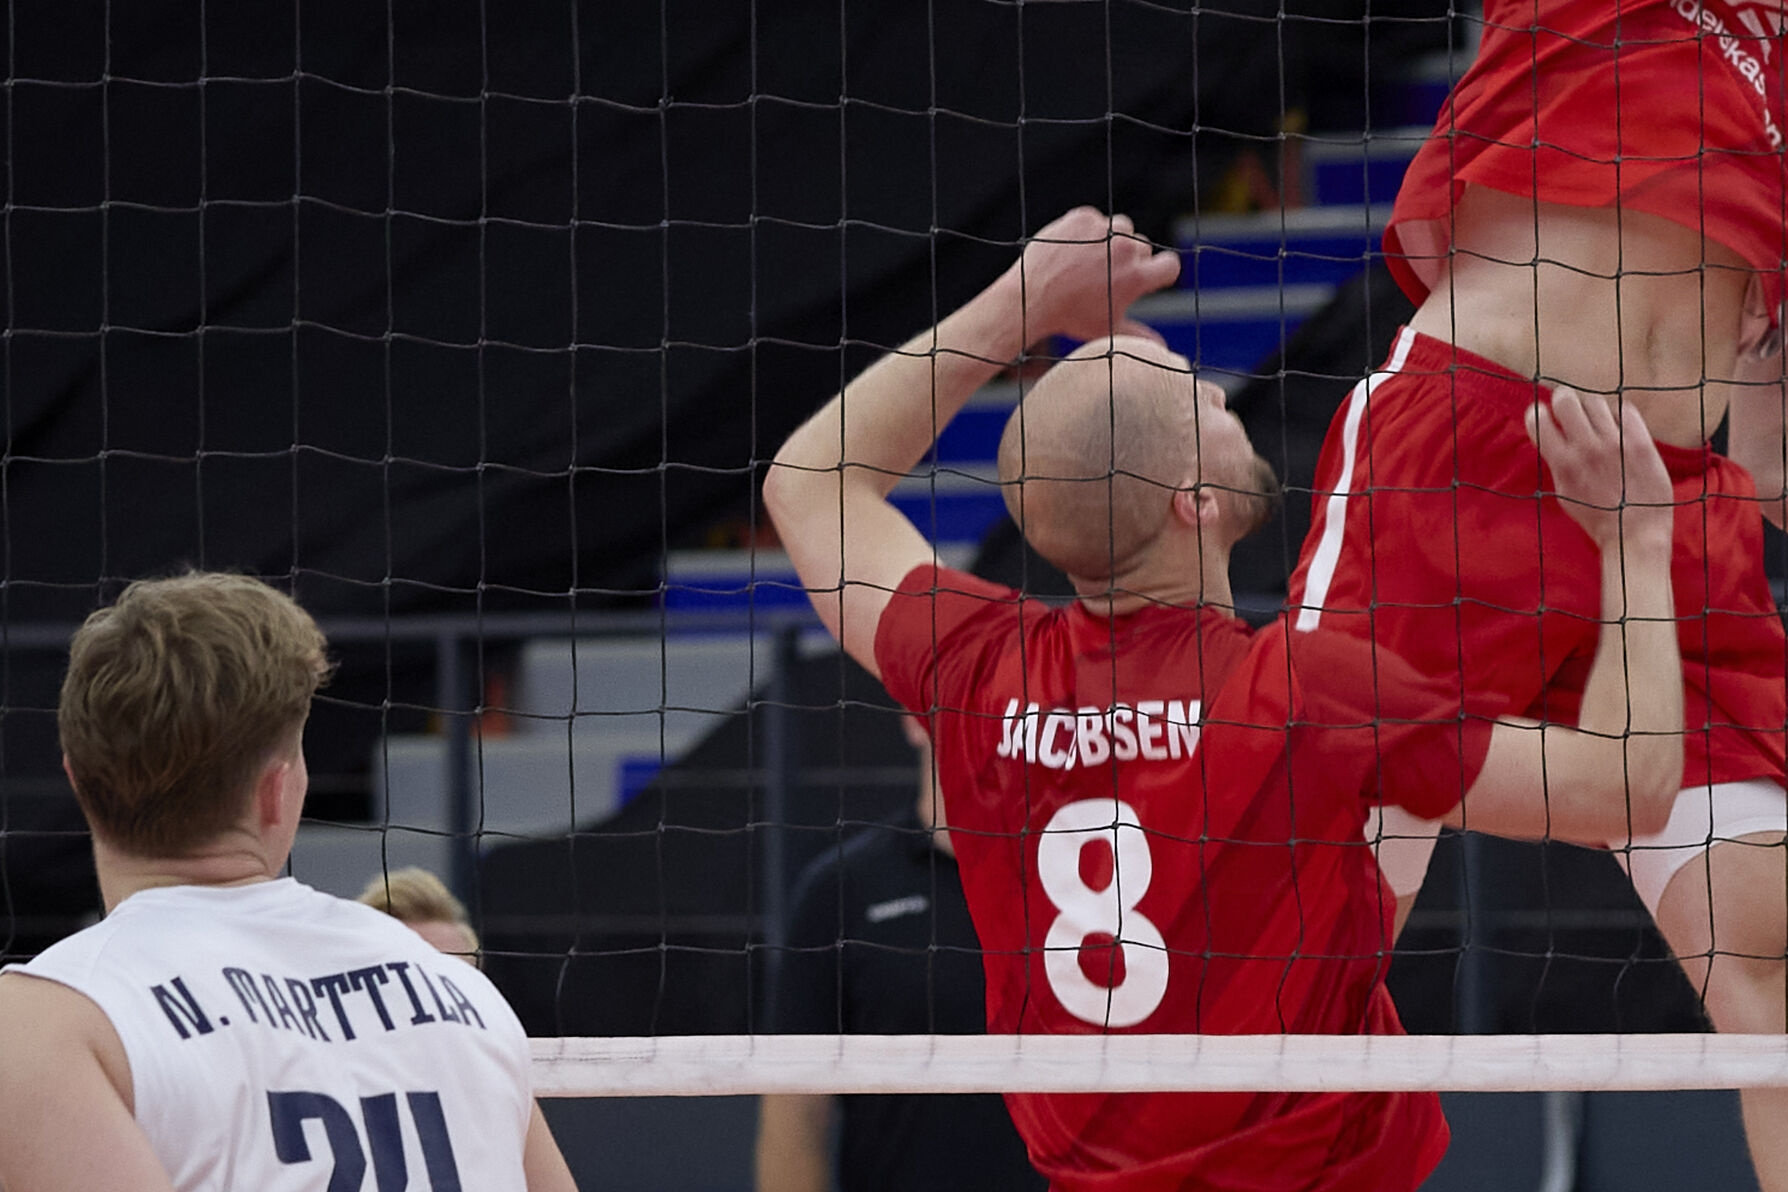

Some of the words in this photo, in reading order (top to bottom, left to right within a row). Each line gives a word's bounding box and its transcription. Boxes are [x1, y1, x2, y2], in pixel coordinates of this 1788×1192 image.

[997, 698, 1202, 771] JACBSEN
[1038, 797, 1169, 1028] 8
[150, 976, 229, 1040] N.
